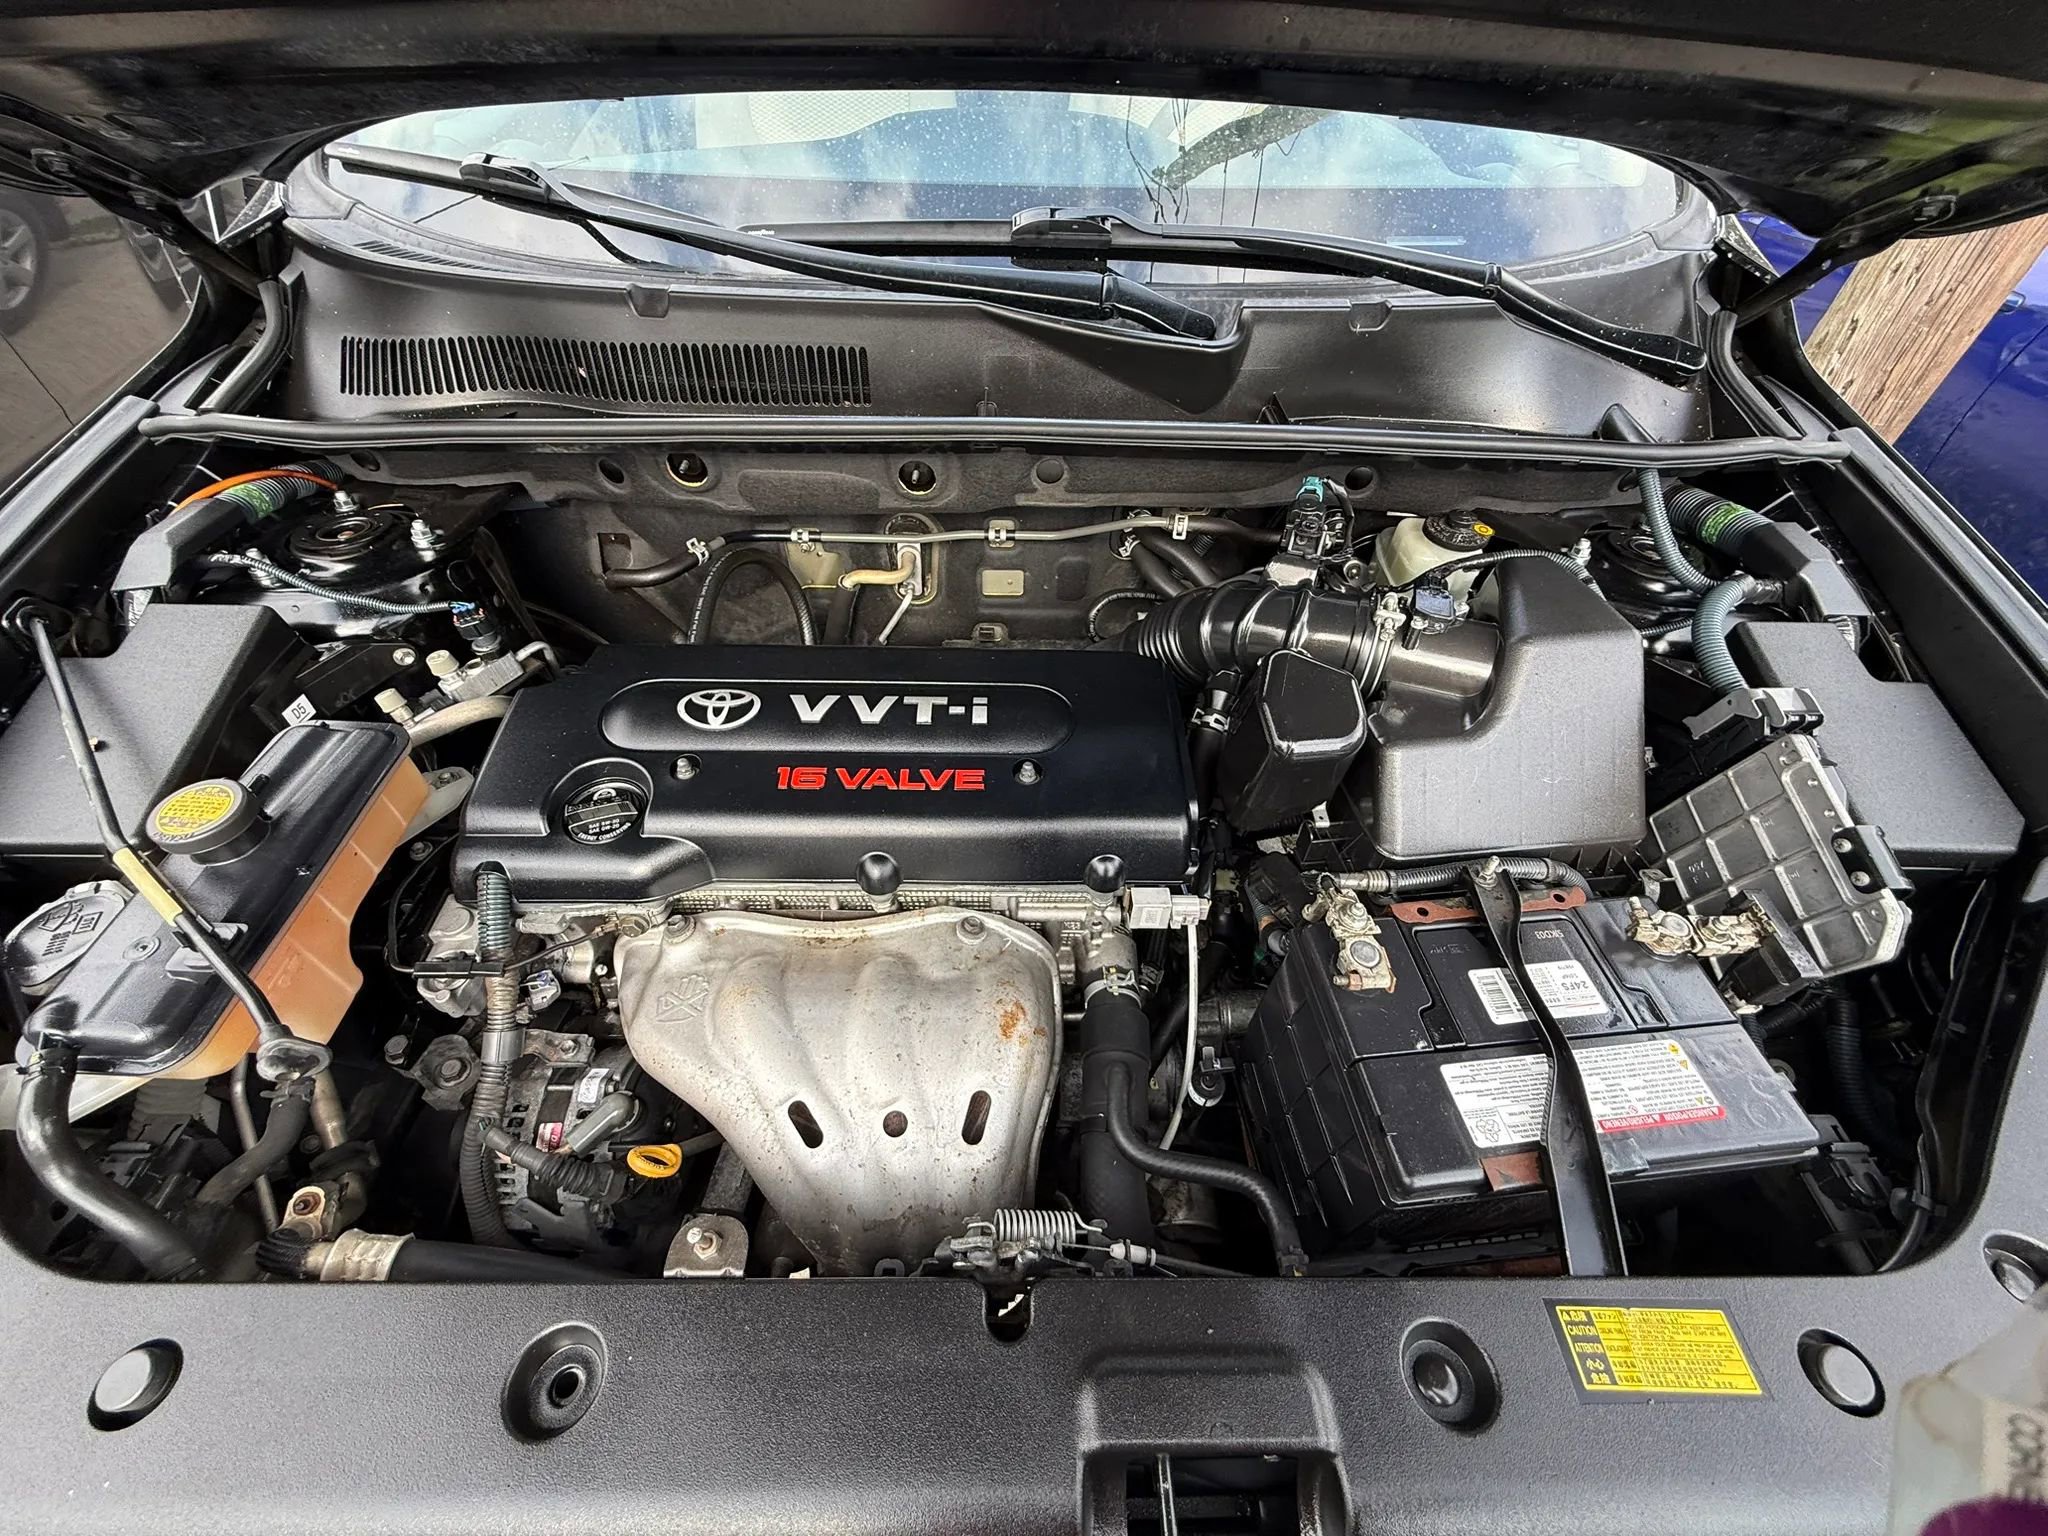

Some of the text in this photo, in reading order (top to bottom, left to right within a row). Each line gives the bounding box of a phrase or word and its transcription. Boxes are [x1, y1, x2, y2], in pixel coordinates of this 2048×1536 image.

[291, 702, 307, 720] D5
[789, 693, 989, 725] VVT-i
[777, 766, 985, 791] 16 VALVE
[1567, 1324, 1598, 1336] CAUTION
[1574, 1342, 1605, 1353] ATTENTION
